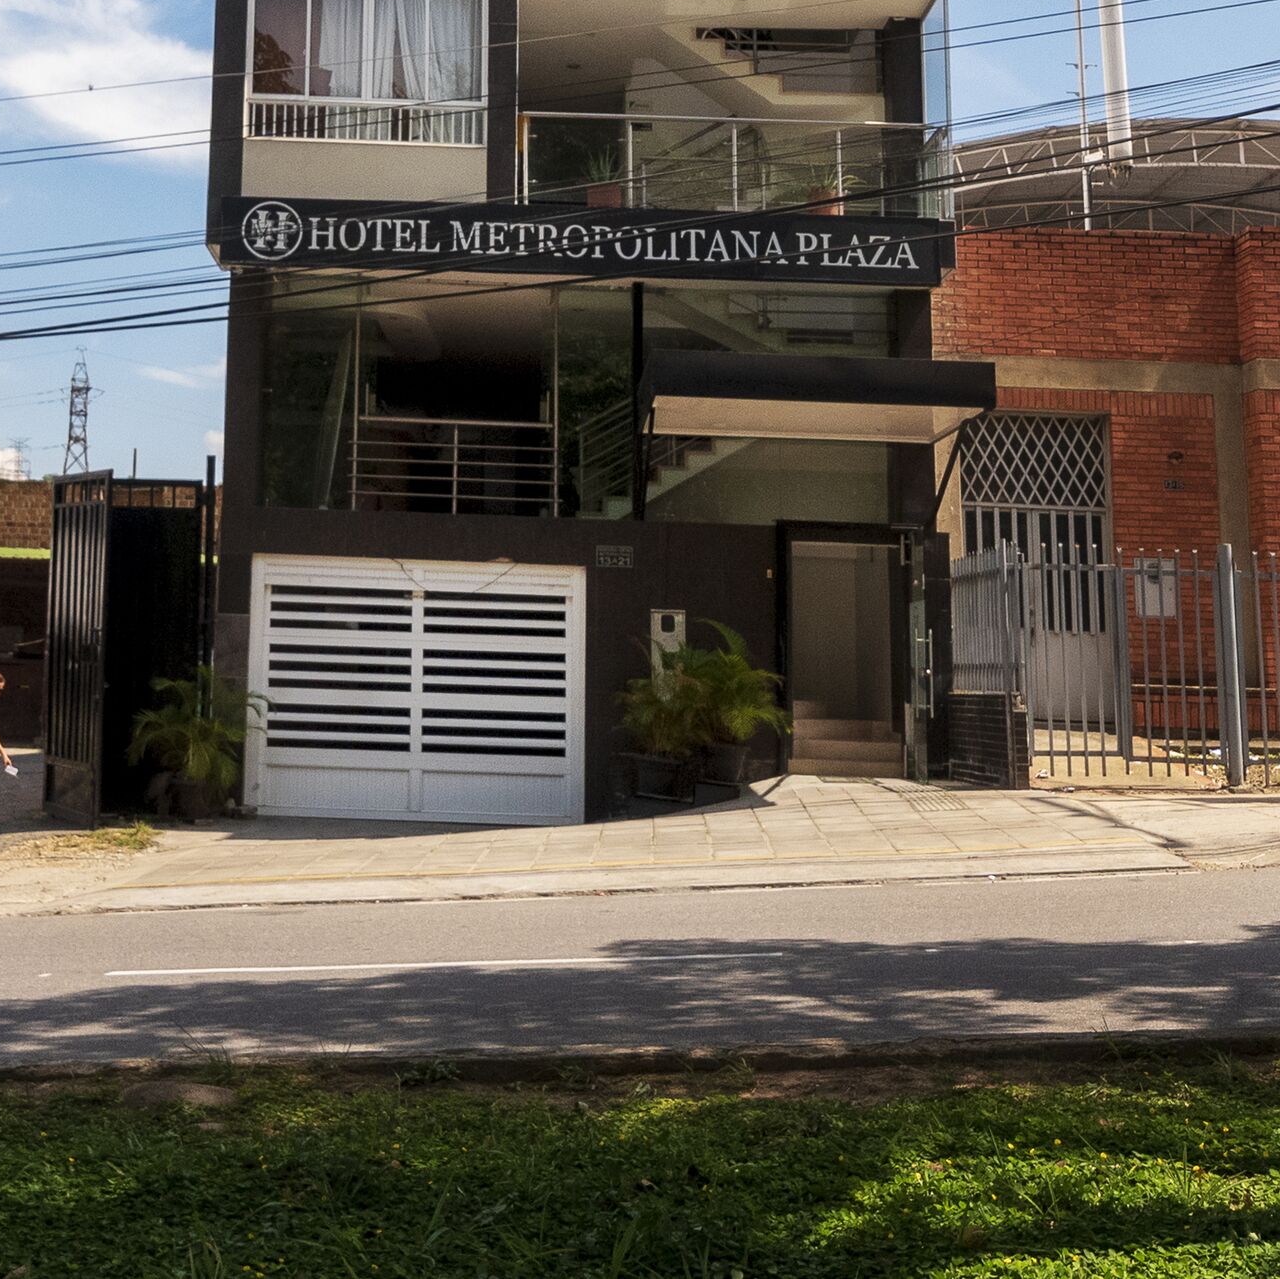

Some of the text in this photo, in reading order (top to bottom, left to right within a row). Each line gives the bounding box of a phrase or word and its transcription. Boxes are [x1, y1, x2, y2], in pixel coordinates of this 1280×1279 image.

[308, 217, 920, 269] HOTEL METROPOLITANA PLAZA
